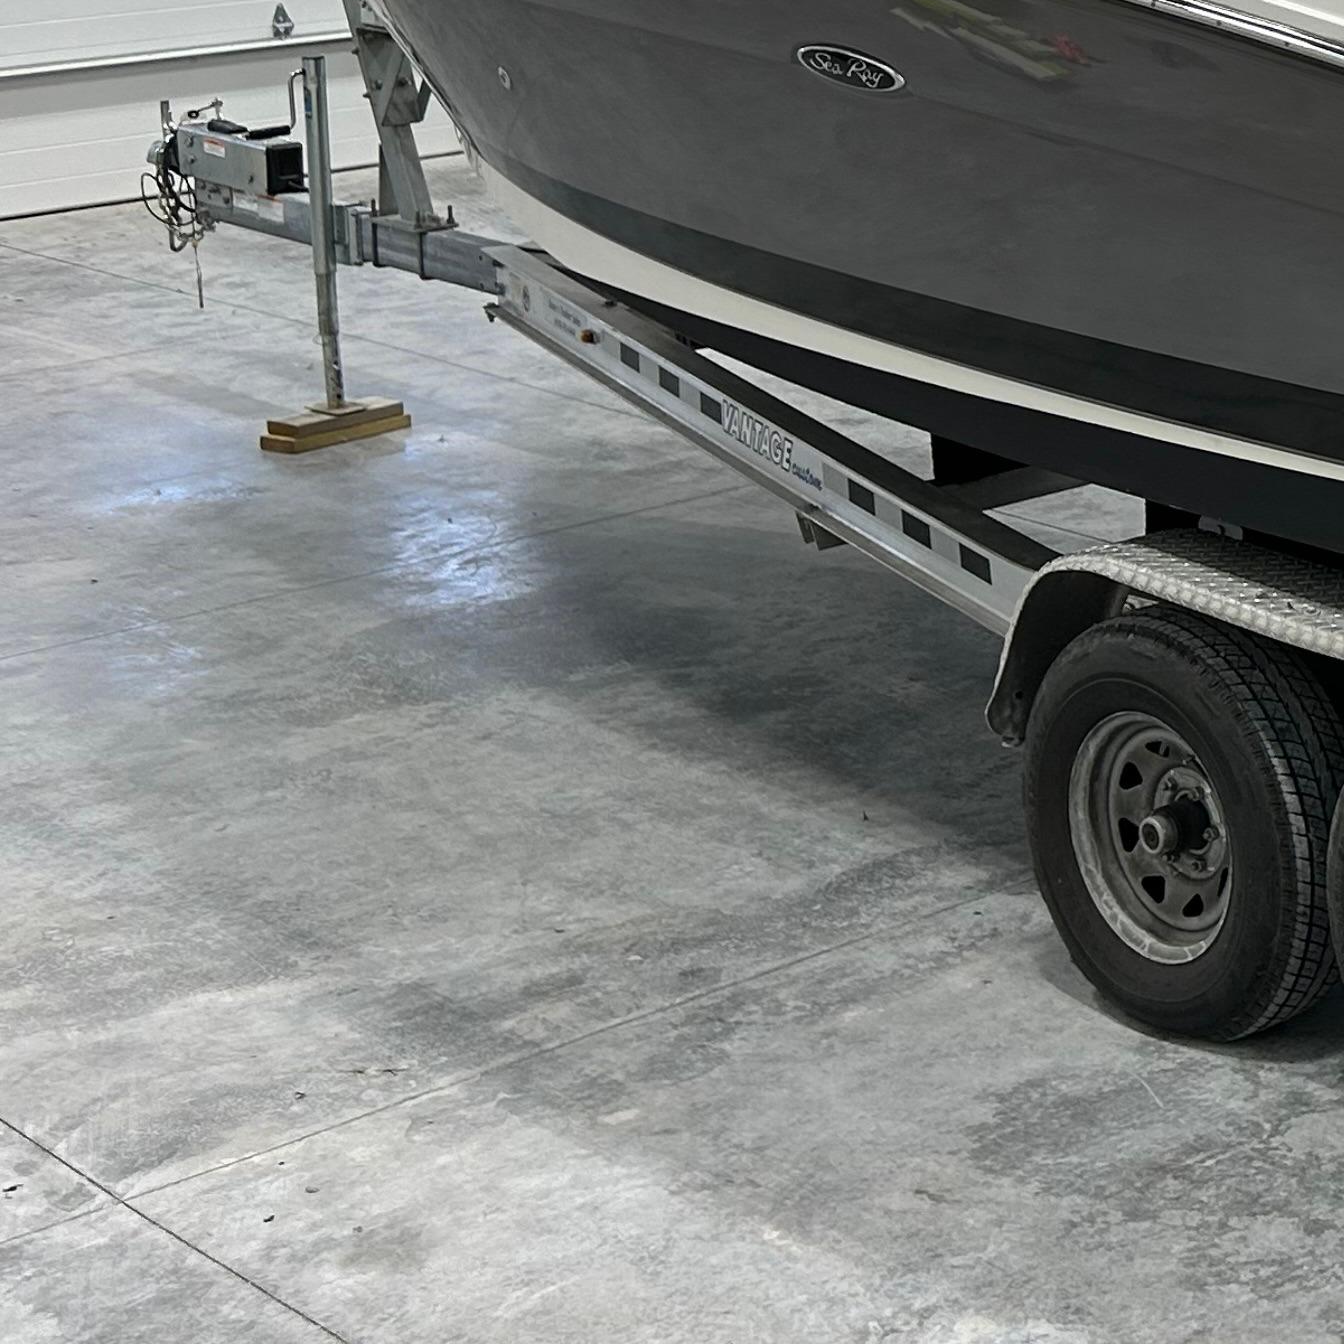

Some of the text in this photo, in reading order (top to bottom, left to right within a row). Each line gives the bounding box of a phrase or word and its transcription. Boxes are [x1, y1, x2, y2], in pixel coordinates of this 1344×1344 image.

[810, 52, 884, 88] Sea Ray
[722, 399, 794, 472] VANTAGE
